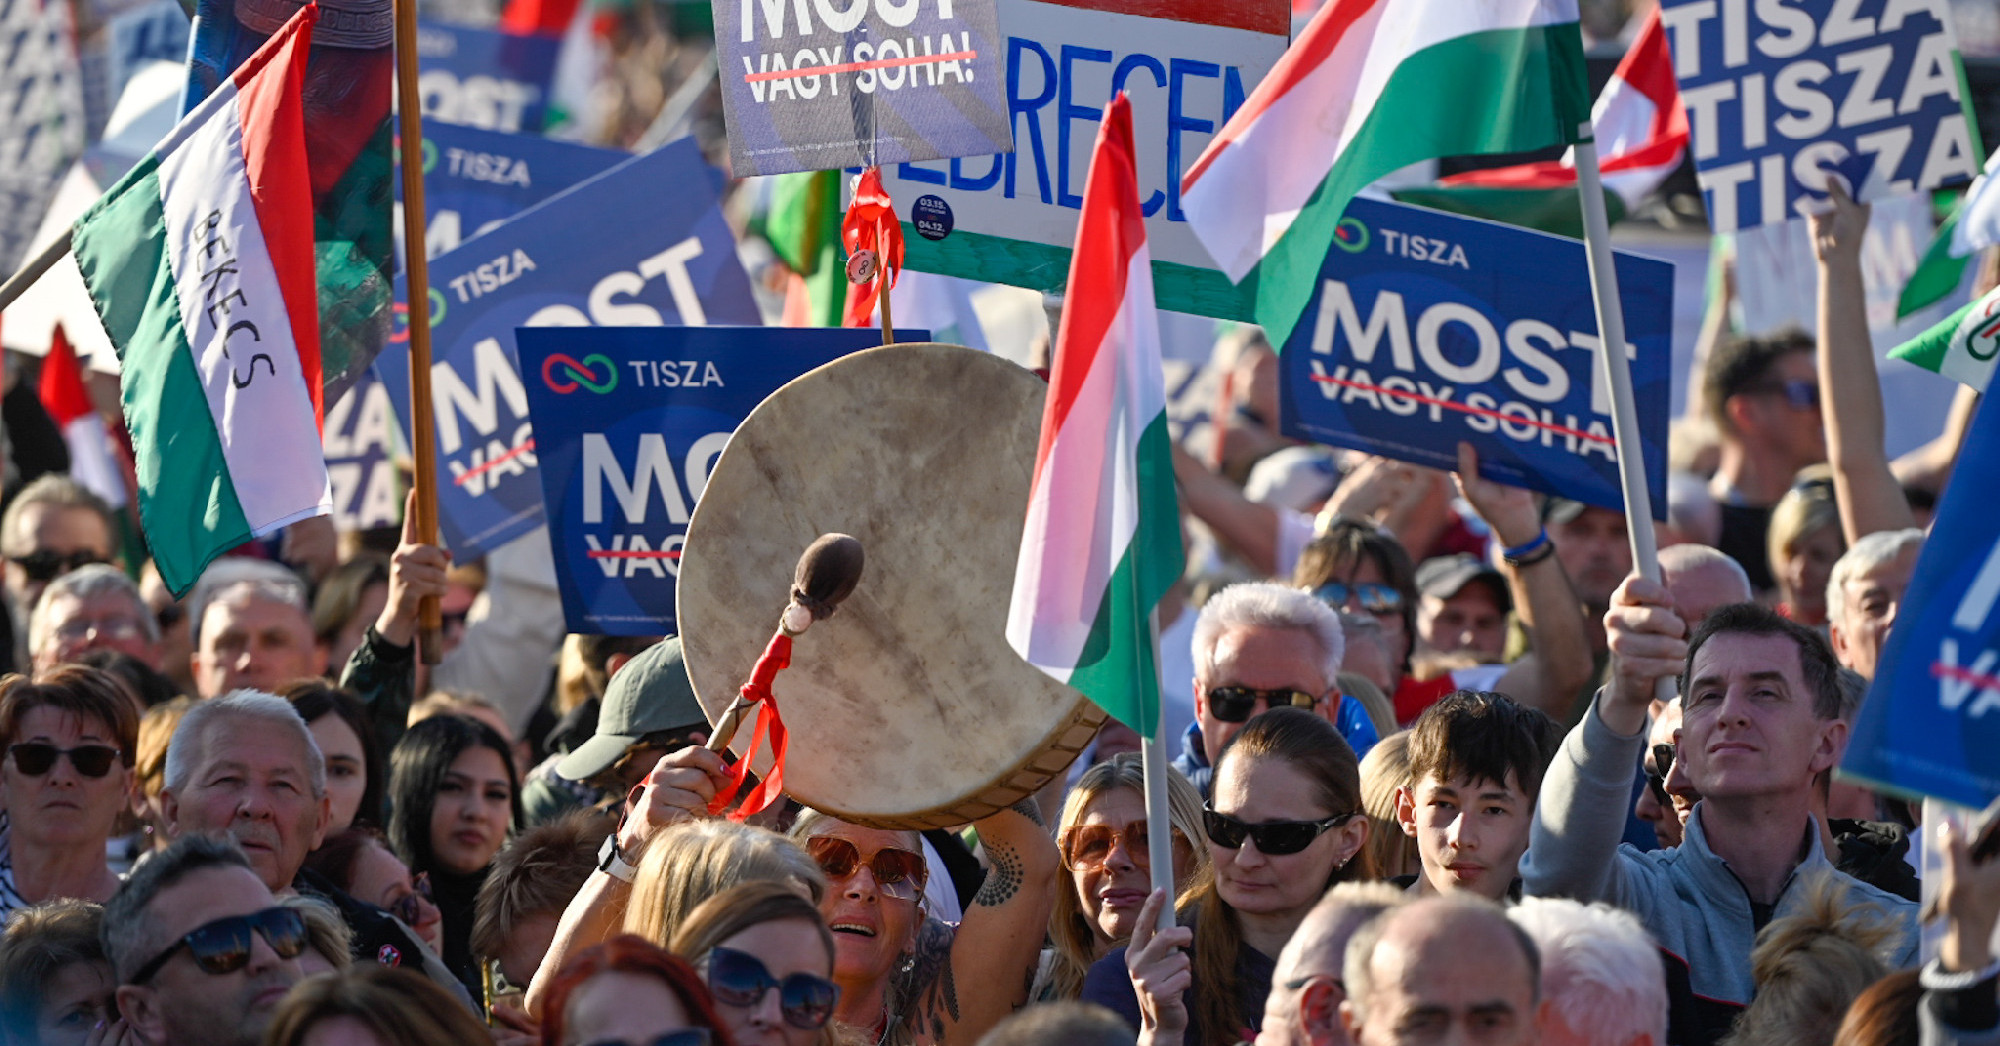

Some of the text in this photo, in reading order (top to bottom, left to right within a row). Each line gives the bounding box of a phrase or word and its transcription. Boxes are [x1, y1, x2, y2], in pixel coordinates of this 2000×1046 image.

[743, 31, 975, 103] VAGY SOHA!
[1679, 31, 1961, 161] TISZA
[420, 69, 541, 134] OST
[445, 147, 532, 188] TISZA
[1697, 113, 1979, 234] TISZA
[450, 249, 537, 303] TISZA
[1379, 228, 1470, 270] TISZA
[194, 209, 275, 389] BEKECS
[431, 237, 707, 455] MST
[628, 361, 724, 388] TISZA
[1311, 278, 1637, 417] MOST
[1310, 359, 1453, 423] VAGY
[449, 421, 539, 498] VA
[584, 534, 686, 578] VA
